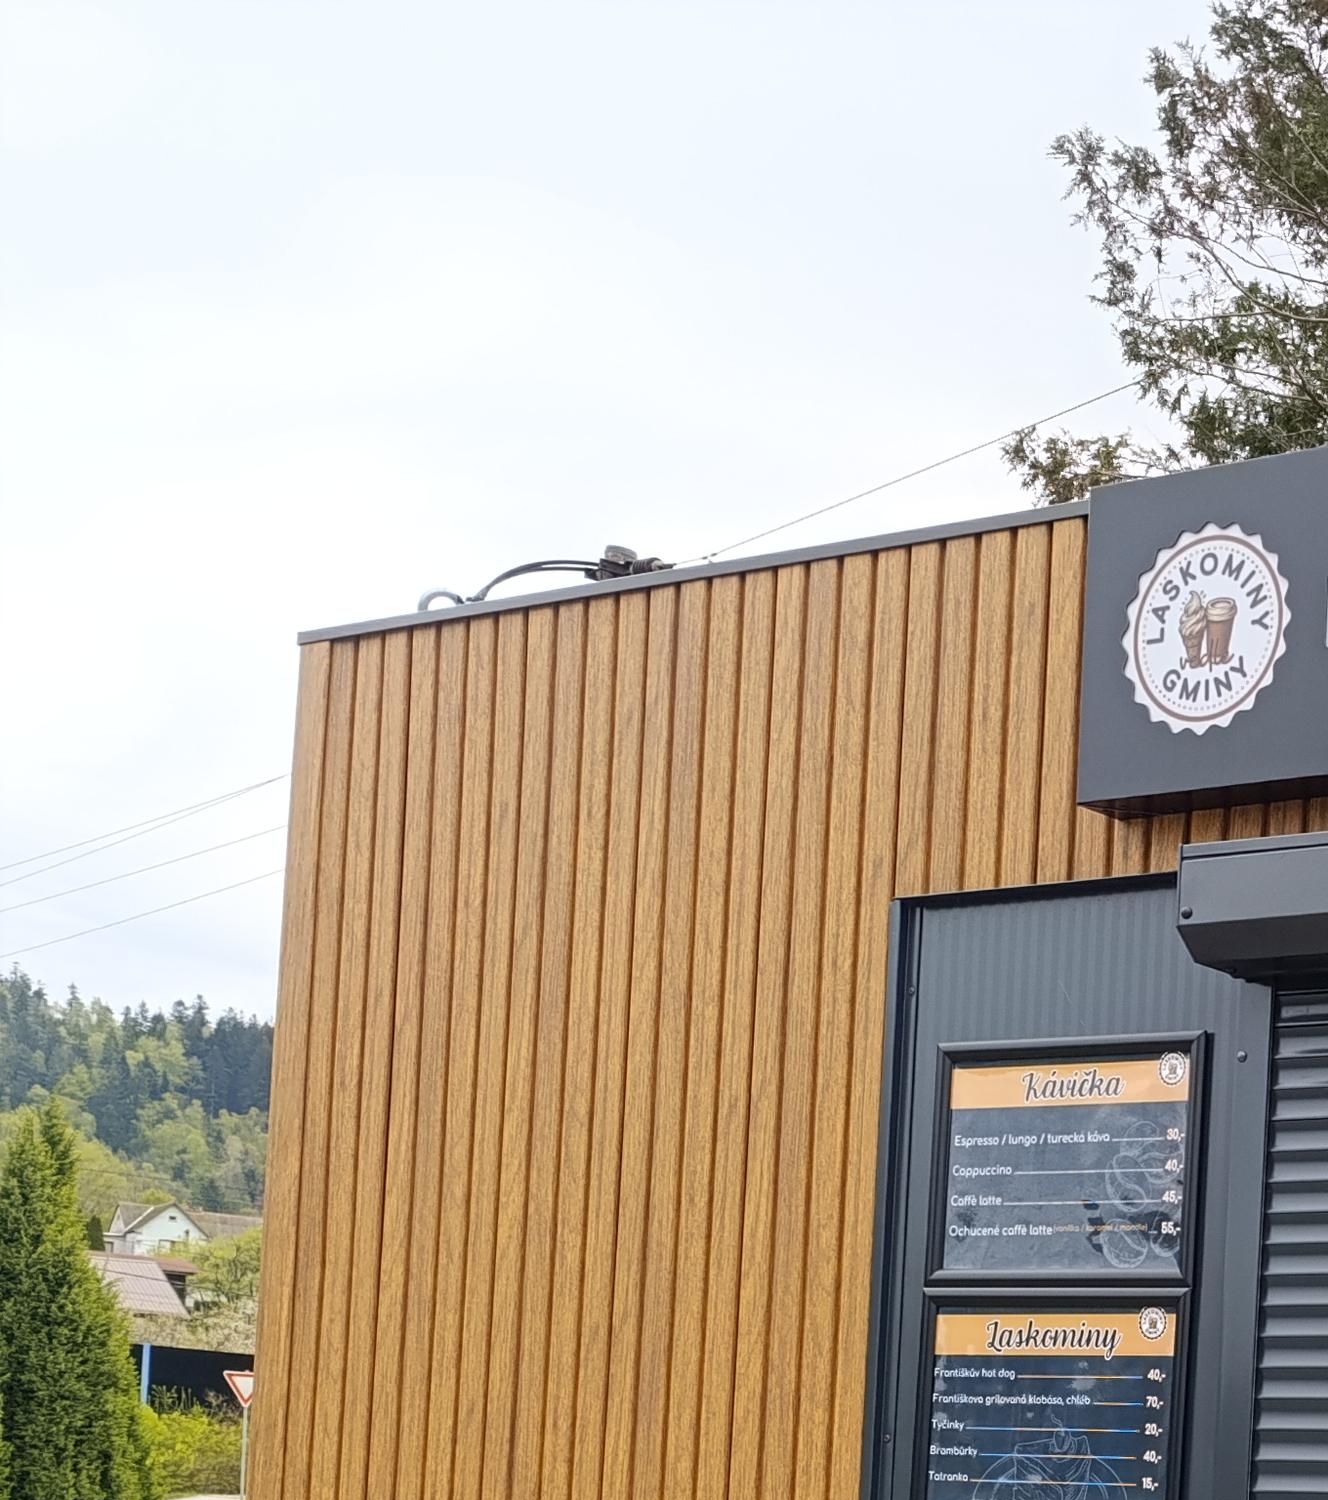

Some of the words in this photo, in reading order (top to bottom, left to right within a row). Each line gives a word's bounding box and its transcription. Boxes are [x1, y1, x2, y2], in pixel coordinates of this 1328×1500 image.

[1146, 552, 1270, 645] LASKOMINY
[1163, 656, 1247, 703] GMINY
[1022, 1069, 1123, 1102] Kávička
[954, 1136, 999, 1147] Espresso
[1002, 1134, 1006, 1145] /
[1009, 1134, 1037, 1147] lungo
[1040, 1133, 1044, 1144] /
[1047, 1132, 1086, 1144] turecká
[1088, 1131, 1110, 1142] káva
[1166, 1129, 1185, 1142] 30,-
[952, 1164, 1012, 1178] Cappuccino
[1165, 1160, 1184, 1172] 40,-
[951, 1195, 977, 1207] Caffè
[979, 1196, 1002, 1206] latte
[949, 1225, 1000, 1236] Ochucené
[1002, 1225, 1027, 1236] caffè
[1029, 1224, 1052, 1236] latte
[1161, 1222, 1181, 1234] 55,-
[987, 1320, 1121, 1359] Laskominy
[934, 1367, 980, 1378] Františkův
[981, 1368, 996, 1378] hot
[998, 1368, 1015, 1380] dog
[1147, 1369, 1166, 1381] 40,-
[932, 1394, 984, 1404] Františkova
[985, 1394, 1026, 1406] grilovaná
[1028, 1395, 1064, 1406] klobása,
[1066, 1395, 1091, 1405] chléb
[1146, 1396, 1164, 1409] 70,-
[931, 1419, 964, 1431] Tyčinky
[1145, 1424, 1163, 1436] 20,-
[930, 1445, 978, 1457] Brambůrky
[1143, 1451, 1162, 1464] 40,-
[929, 1471, 968, 1482] Tatranka
[1142, 1478, 1159, 1491] 15,-
